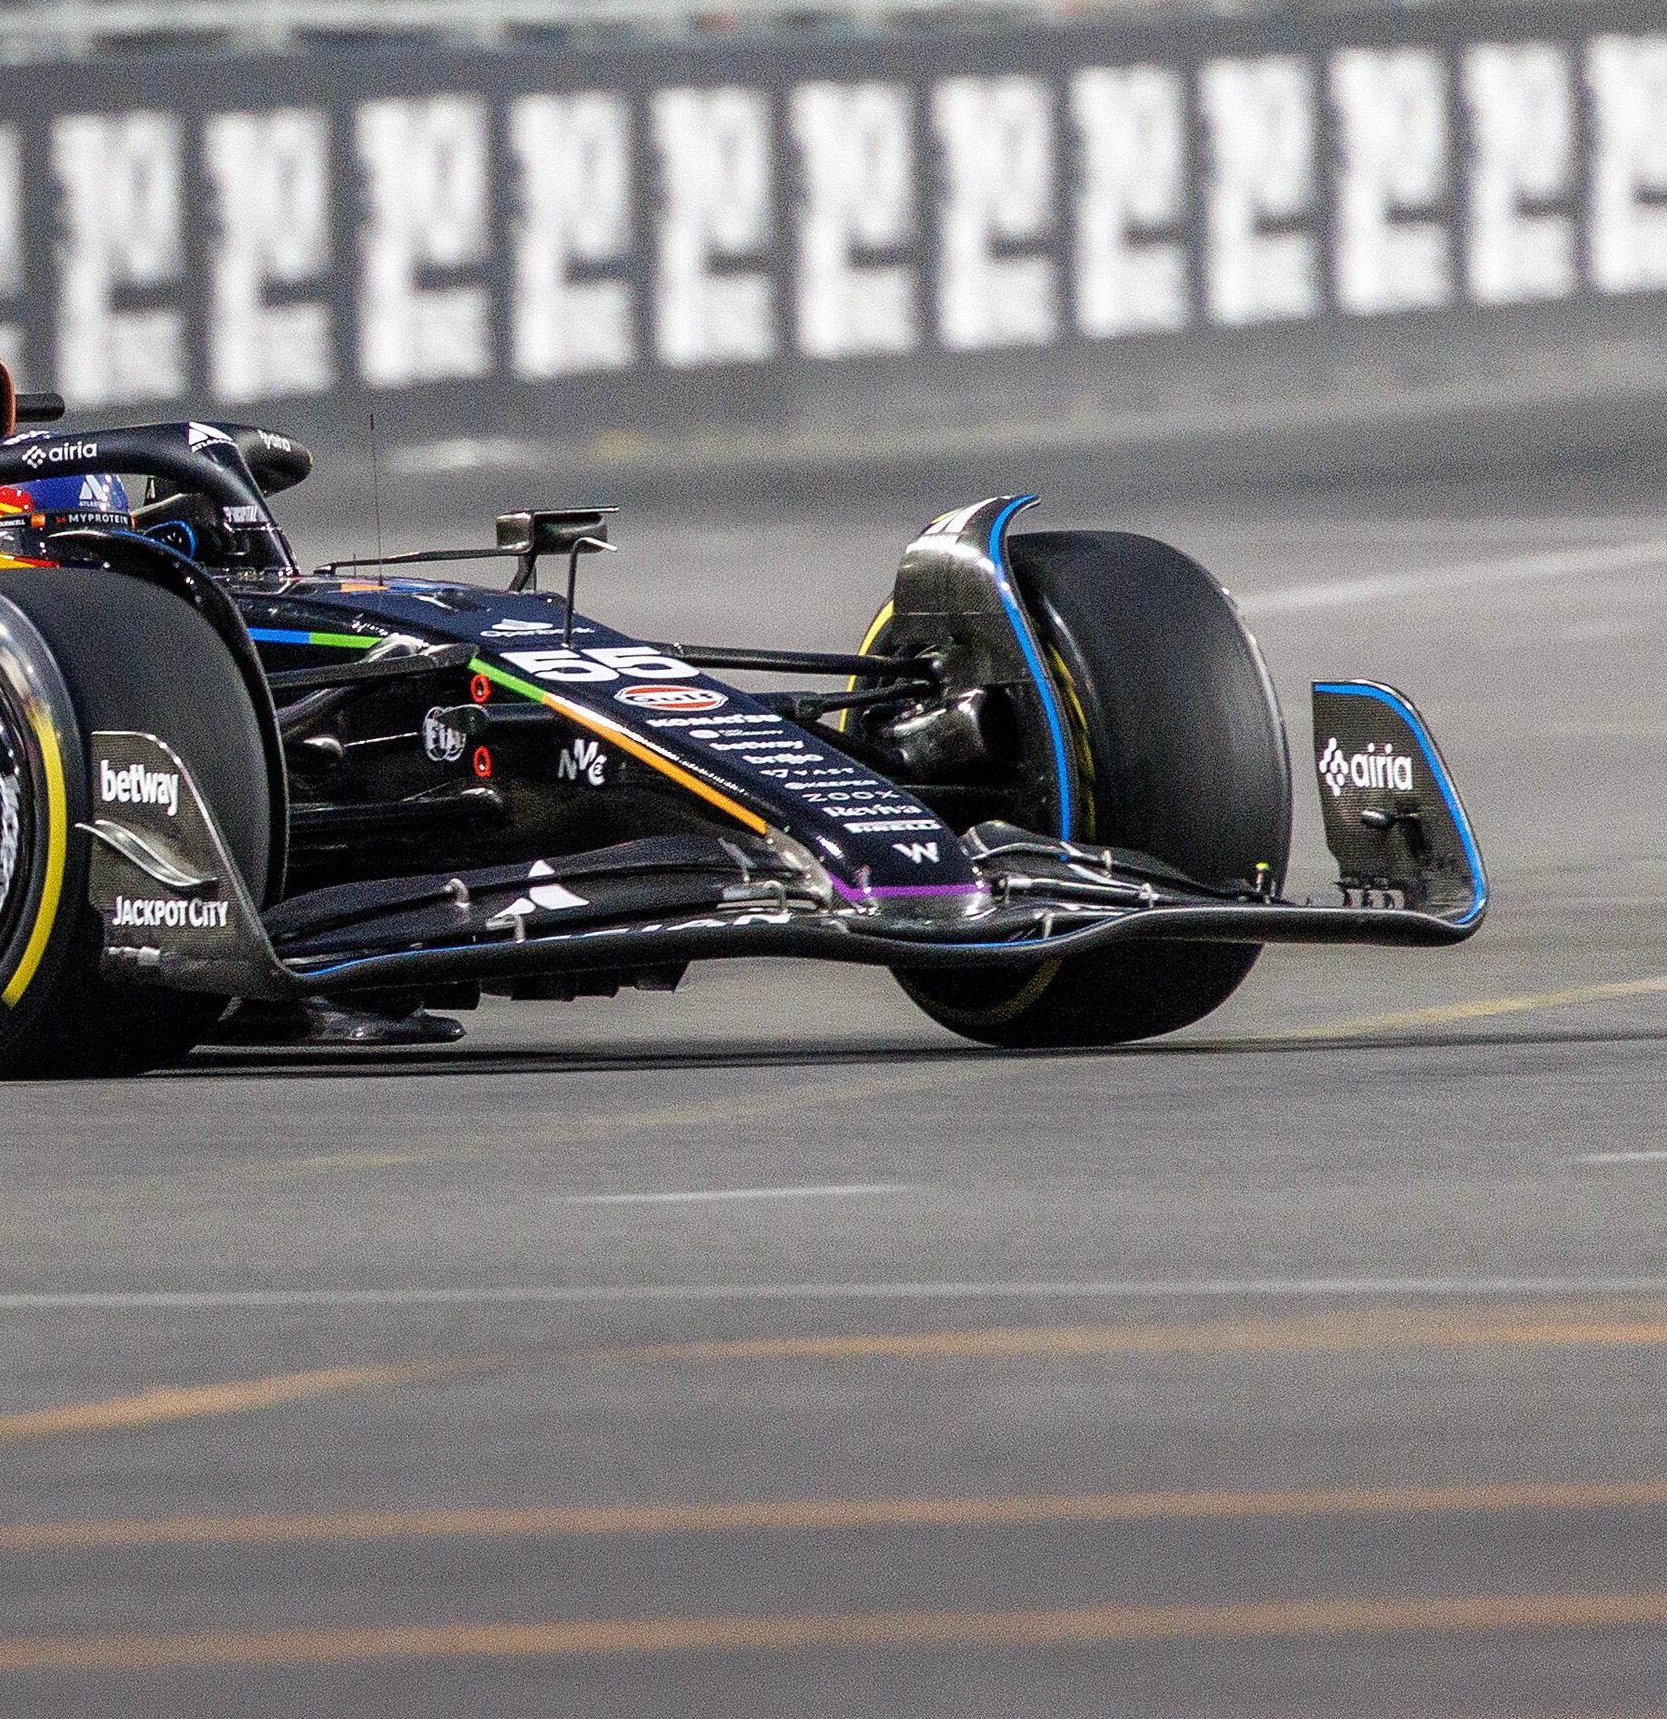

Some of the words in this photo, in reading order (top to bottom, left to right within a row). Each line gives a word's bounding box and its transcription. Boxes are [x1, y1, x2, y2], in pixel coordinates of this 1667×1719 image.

[49, 440, 97, 463] airia
[68, 513, 129, 525] MYPROTEIN
[500, 646, 701, 682] 55
[1351, 742, 1413, 790] airia
[100, 759, 179, 816] betway
